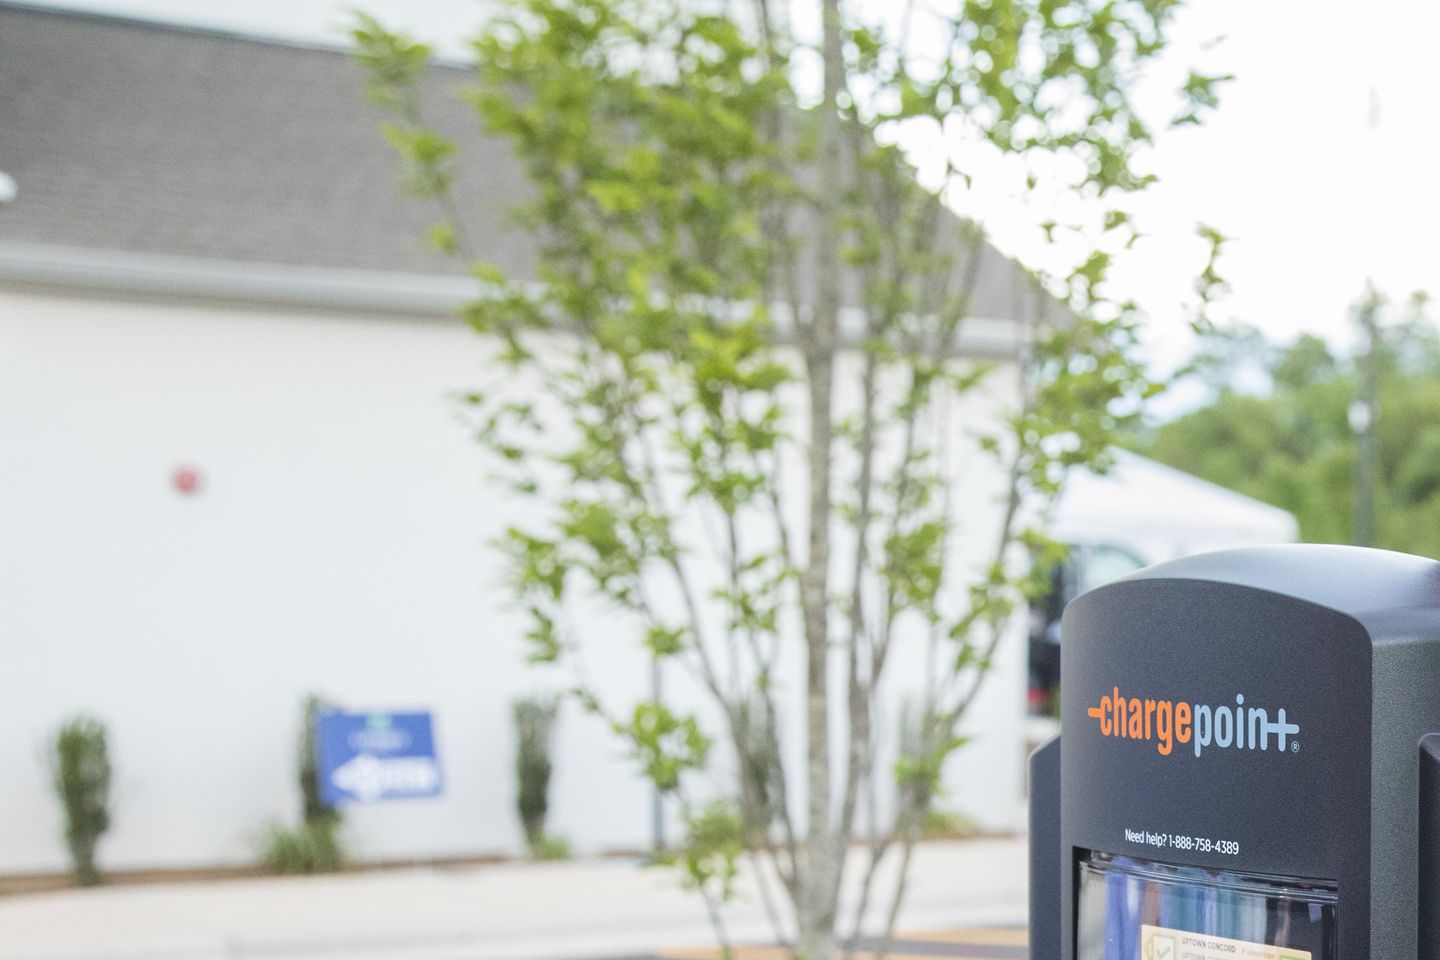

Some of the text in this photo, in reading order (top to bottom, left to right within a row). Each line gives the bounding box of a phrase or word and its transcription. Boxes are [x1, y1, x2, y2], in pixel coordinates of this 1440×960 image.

[1125, 828, 1240, 855] Need help? 1-888-758-4389
[1182, 937, 1236, 954] UPTOWN CONCORD
